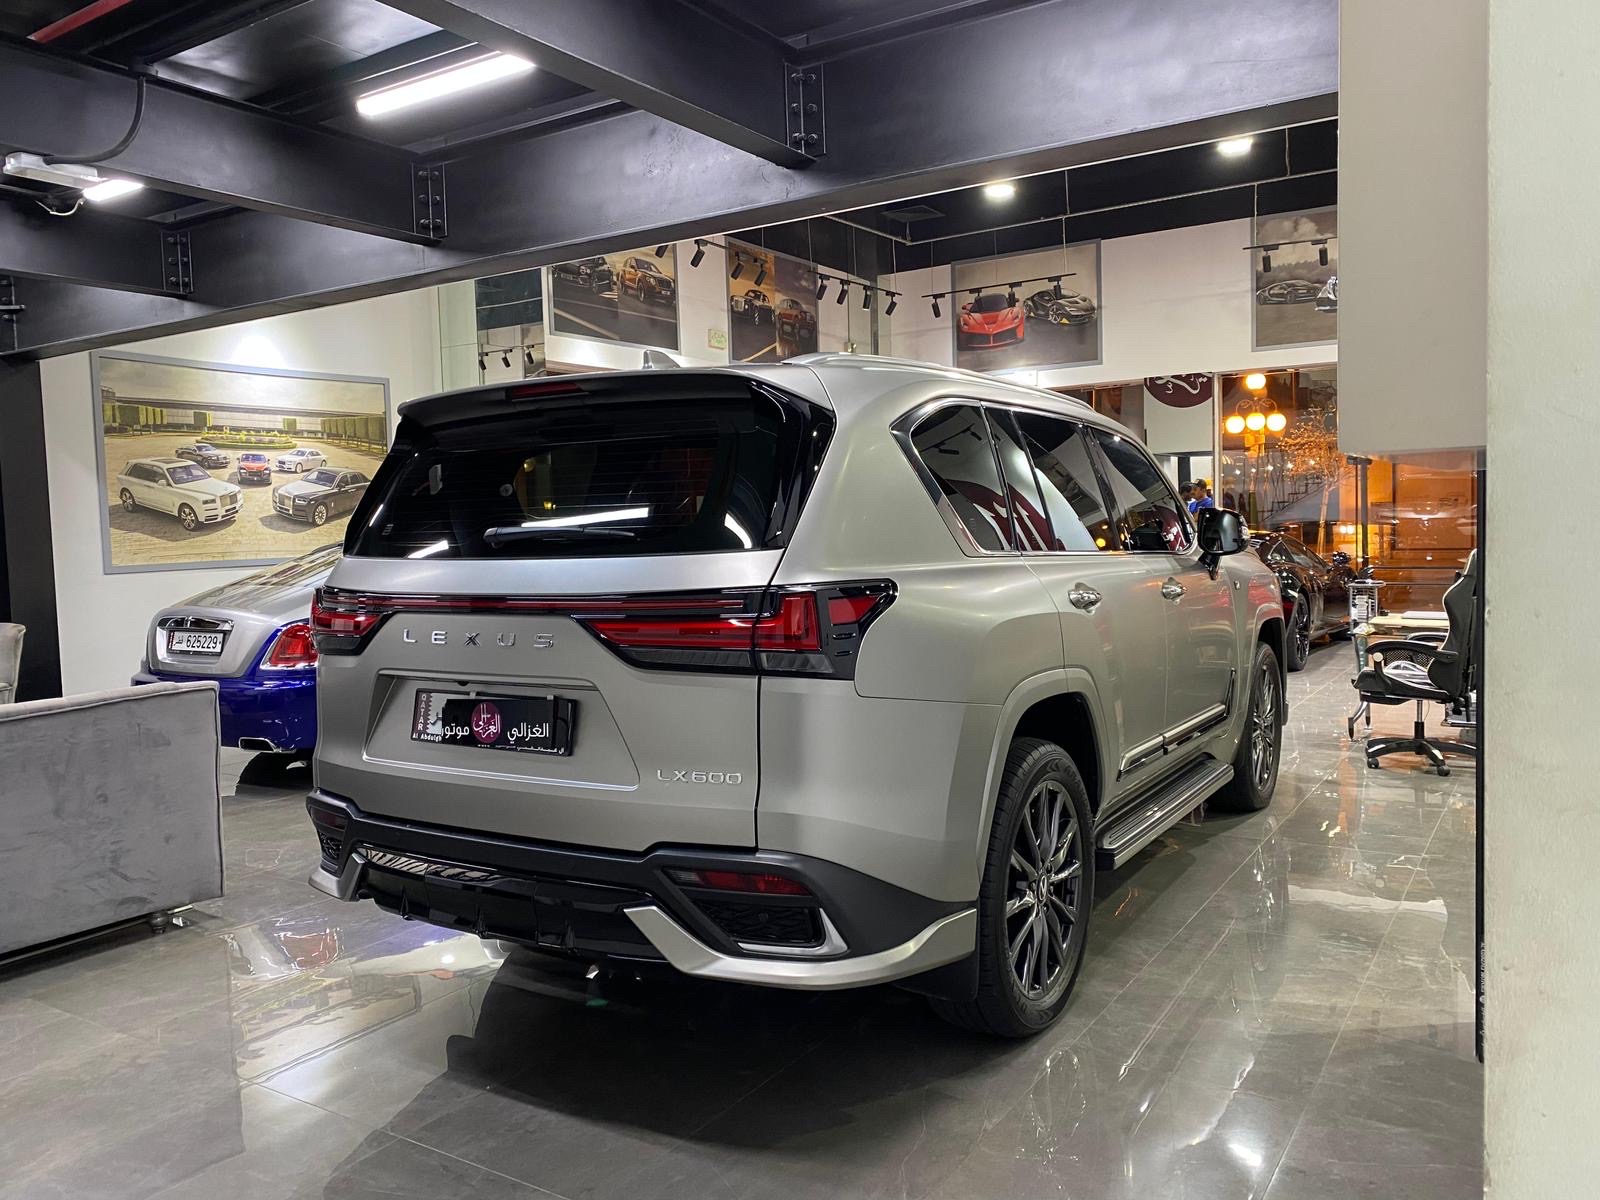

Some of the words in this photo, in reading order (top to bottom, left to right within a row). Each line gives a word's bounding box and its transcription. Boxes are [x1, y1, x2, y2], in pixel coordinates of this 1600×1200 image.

[186, 635, 218, 649] 625229
[403, 629, 553, 648] LEXUS
[418, 694, 427, 731] QATAR
[657, 770, 742, 784] LX600
